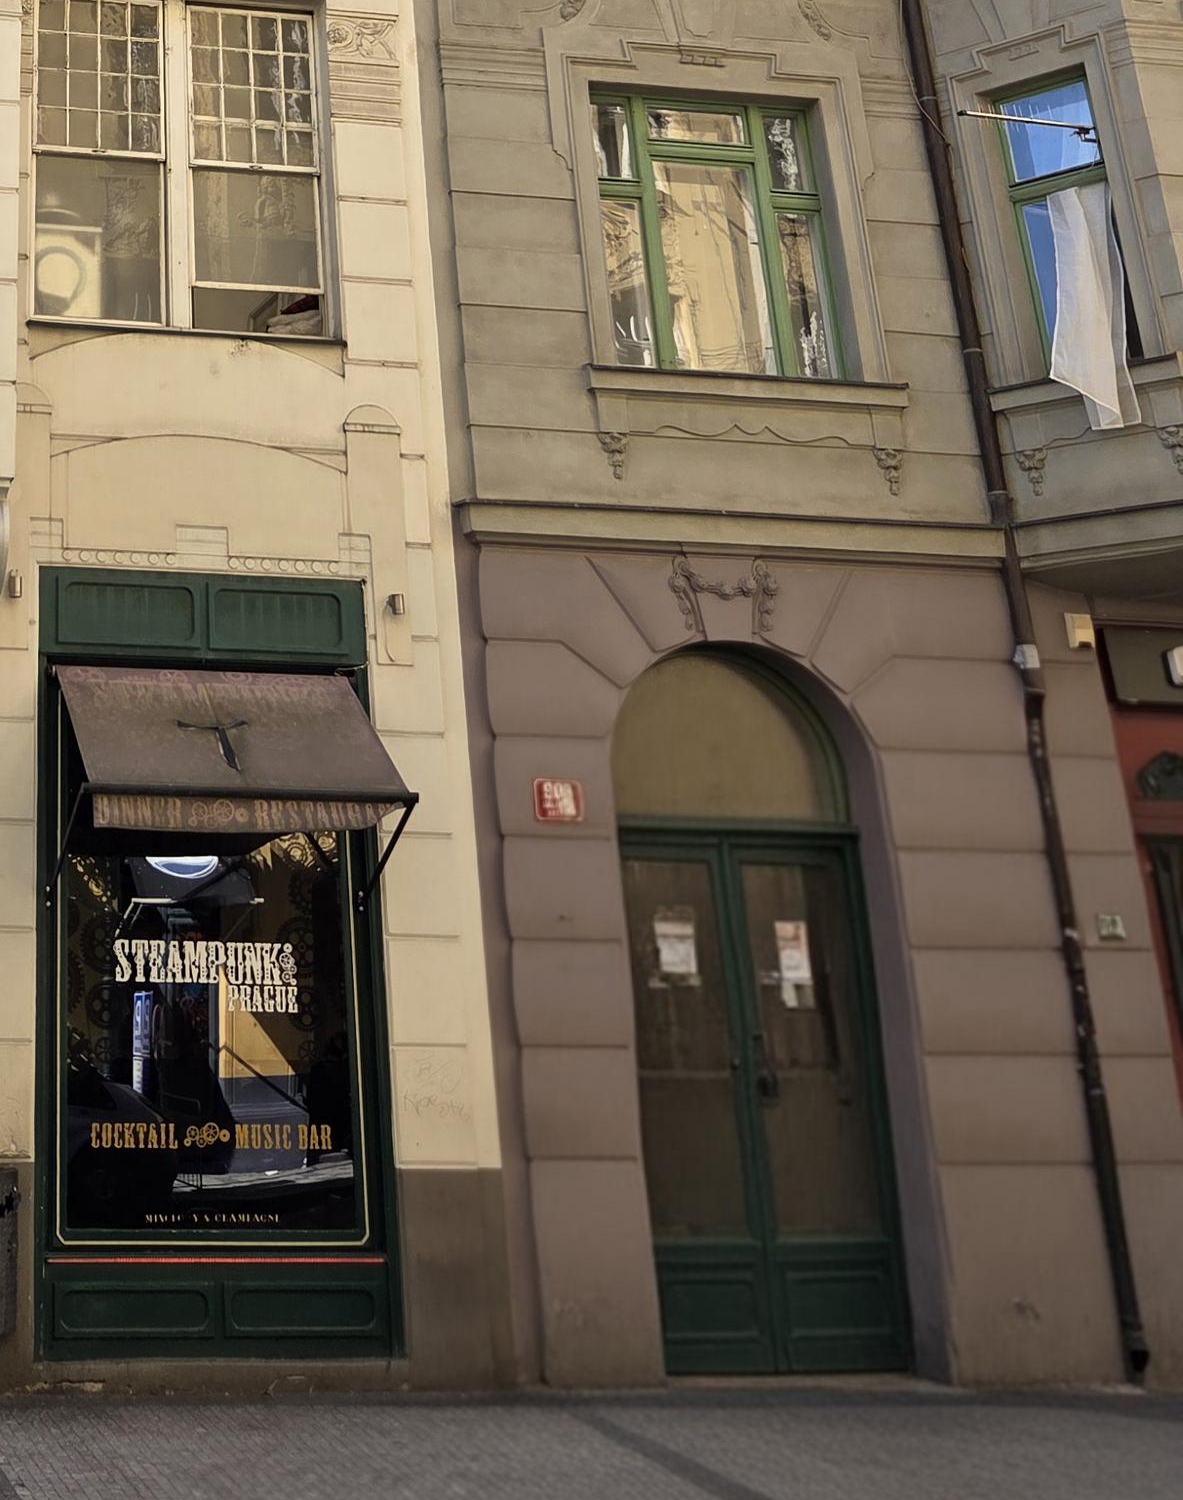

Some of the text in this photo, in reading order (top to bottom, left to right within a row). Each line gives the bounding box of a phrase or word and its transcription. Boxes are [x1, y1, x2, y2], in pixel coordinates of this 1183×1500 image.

[113, 939, 283, 985] STEAMPUNK
[227, 985, 299, 1014] PRAGUE
[90, 1122, 333, 1150] COCKTAIL MUSIC BAR
